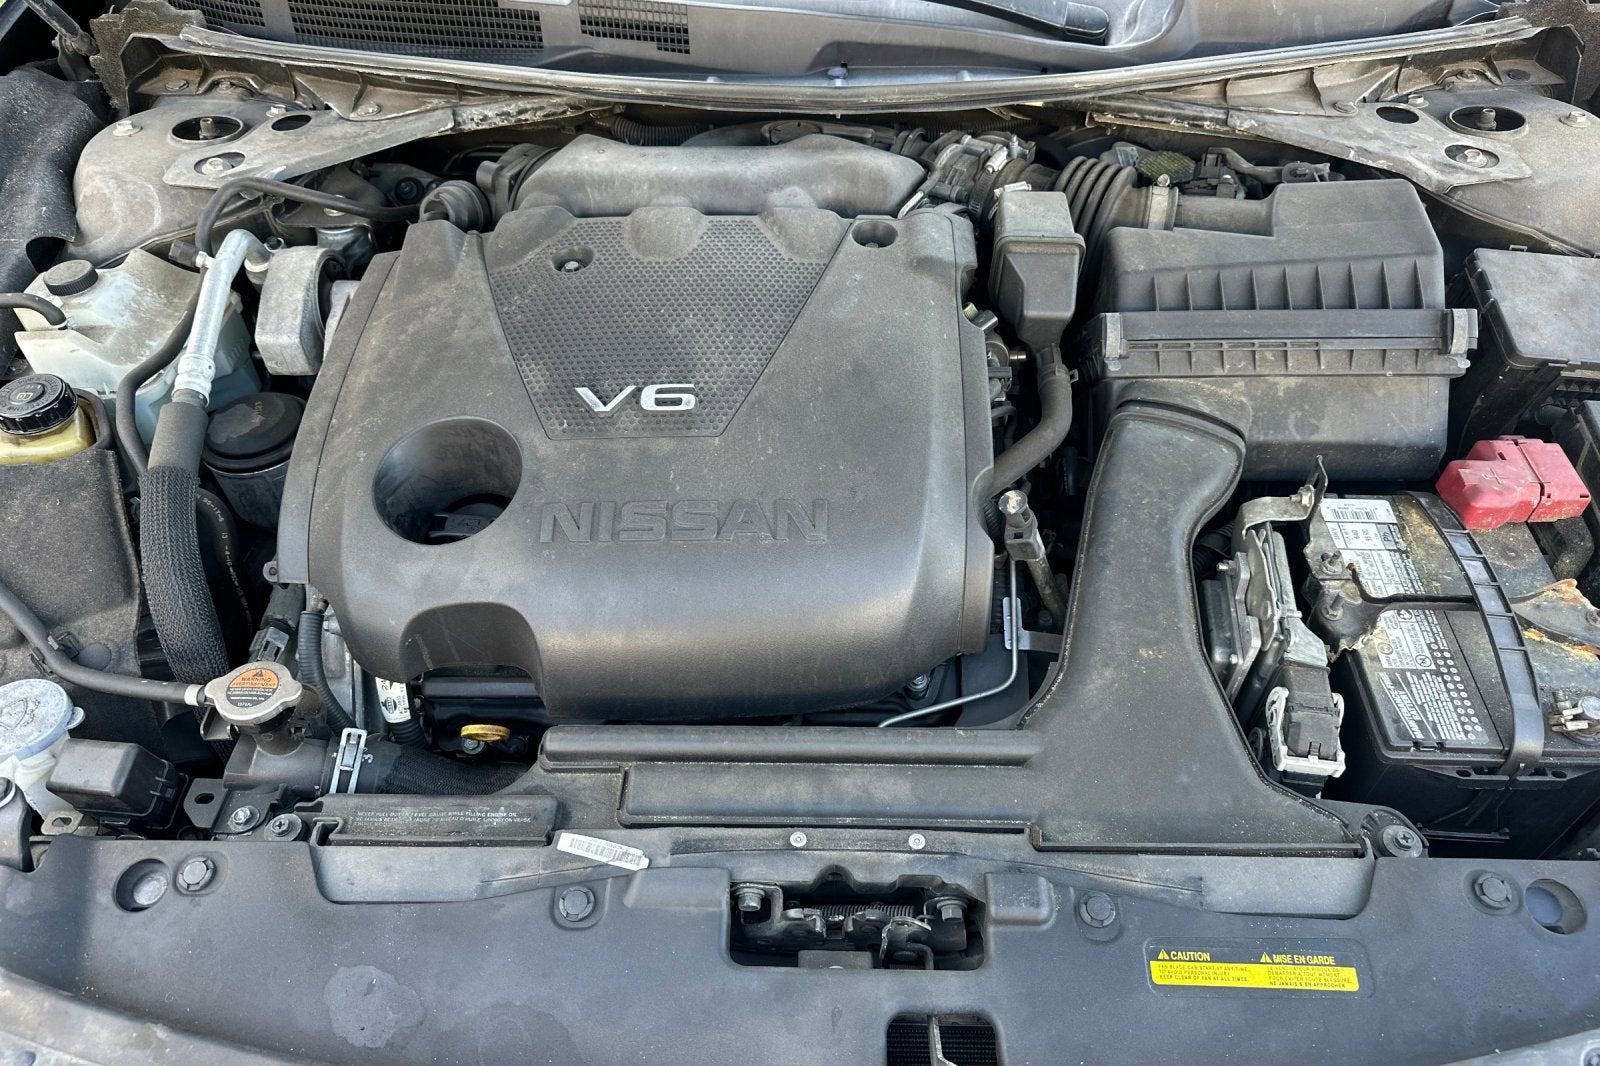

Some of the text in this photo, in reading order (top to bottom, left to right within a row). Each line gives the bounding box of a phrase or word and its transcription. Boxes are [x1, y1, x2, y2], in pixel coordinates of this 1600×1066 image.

[574, 384, 696, 412] V6
[540, 500, 829, 543] NISSAN
[1382, 531, 1392, 542] Pb
[1379, 672, 1425, 739] MAINTENANCE-FREE
[1397, 690, 1422, 721] BATTERY
[1170, 951, 1211, 961] CAUTION
[1272, 954, 1336, 965] MISE EN GARDE
